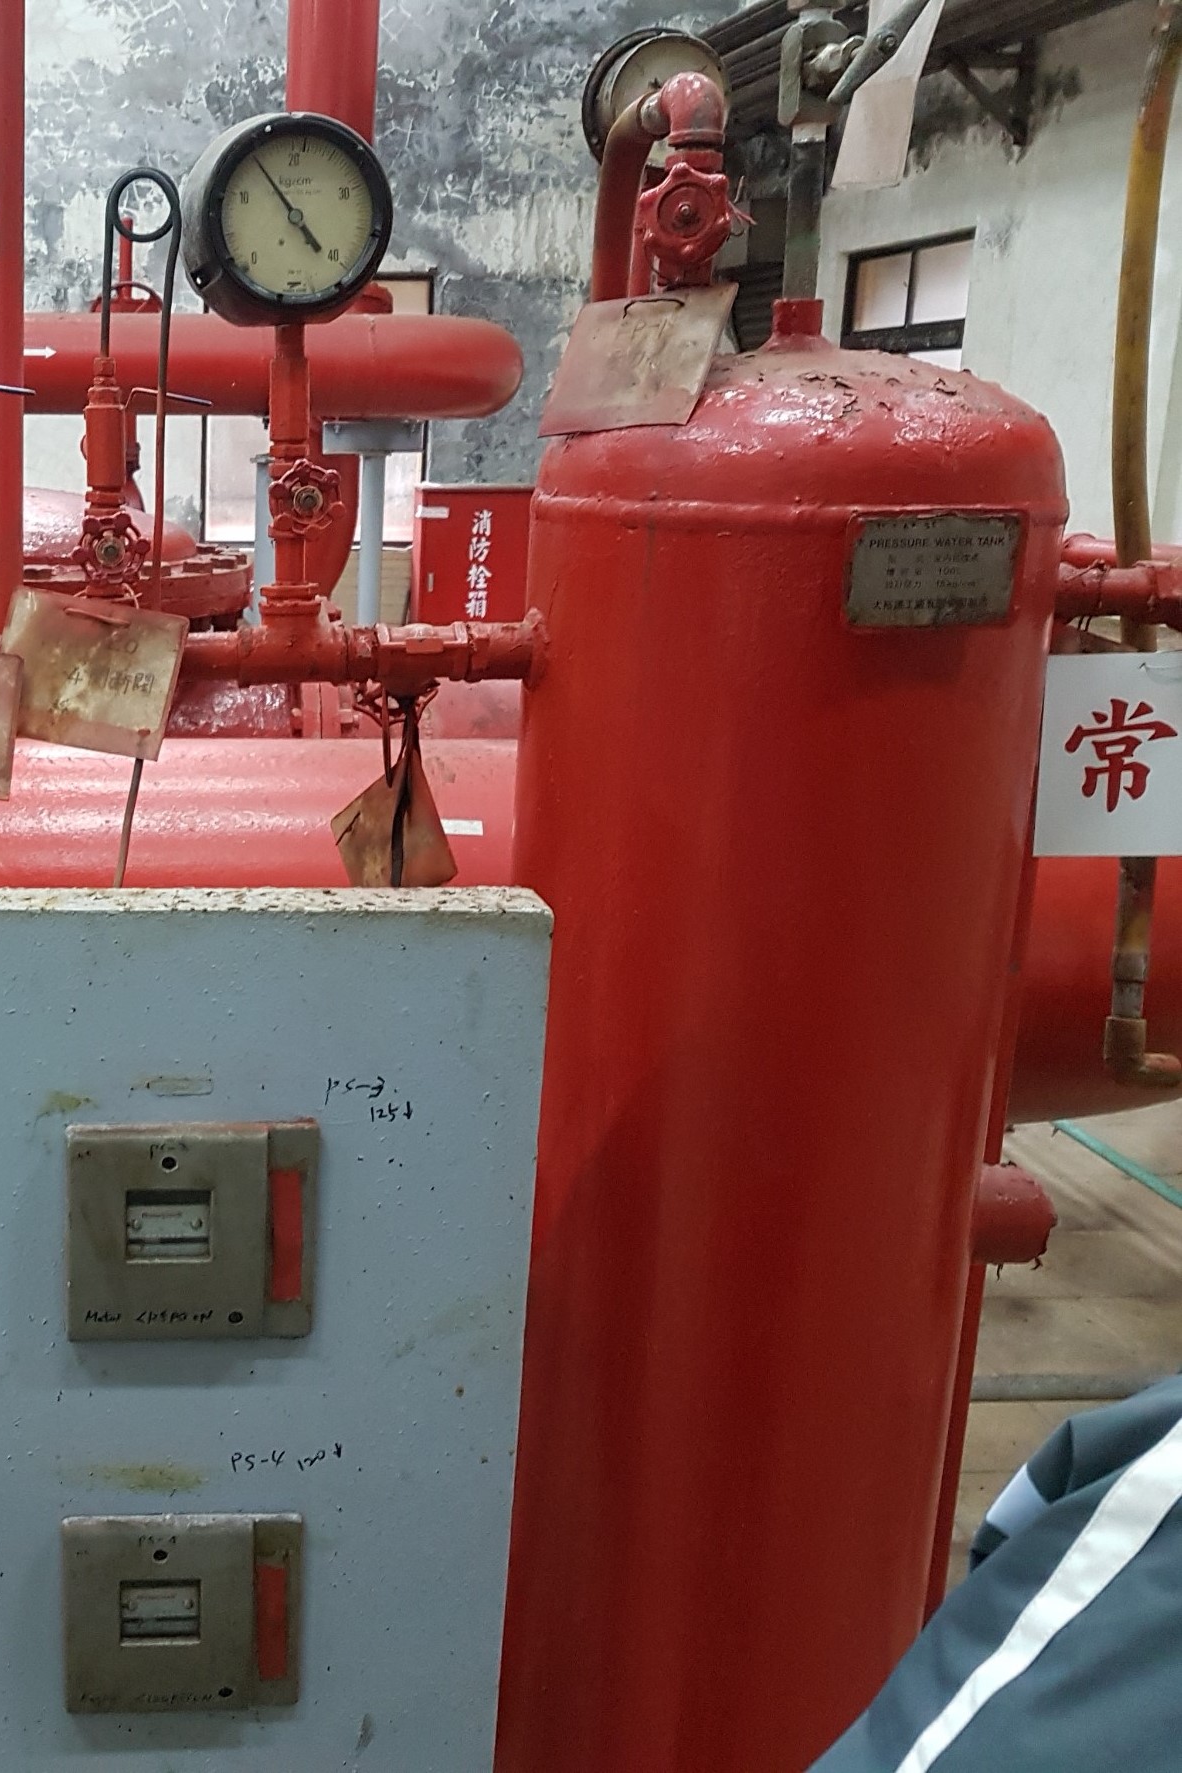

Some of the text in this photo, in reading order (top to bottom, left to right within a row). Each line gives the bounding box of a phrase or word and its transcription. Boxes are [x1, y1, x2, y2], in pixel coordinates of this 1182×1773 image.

[288, 152, 300, 166] 20
[239, 191, 249, 204] 10
[338, 187, 350, 201] 30
[251, 251, 258, 265] 0
[327, 248, 339, 262] 40
[869, 537, 1006, 549] PRESSURE WATER TANK
[465, 508, 494, 620] 消防栓箱
[1064, 698, 1179, 813] 常
[230, 1450, 286, 1473] PS-4
